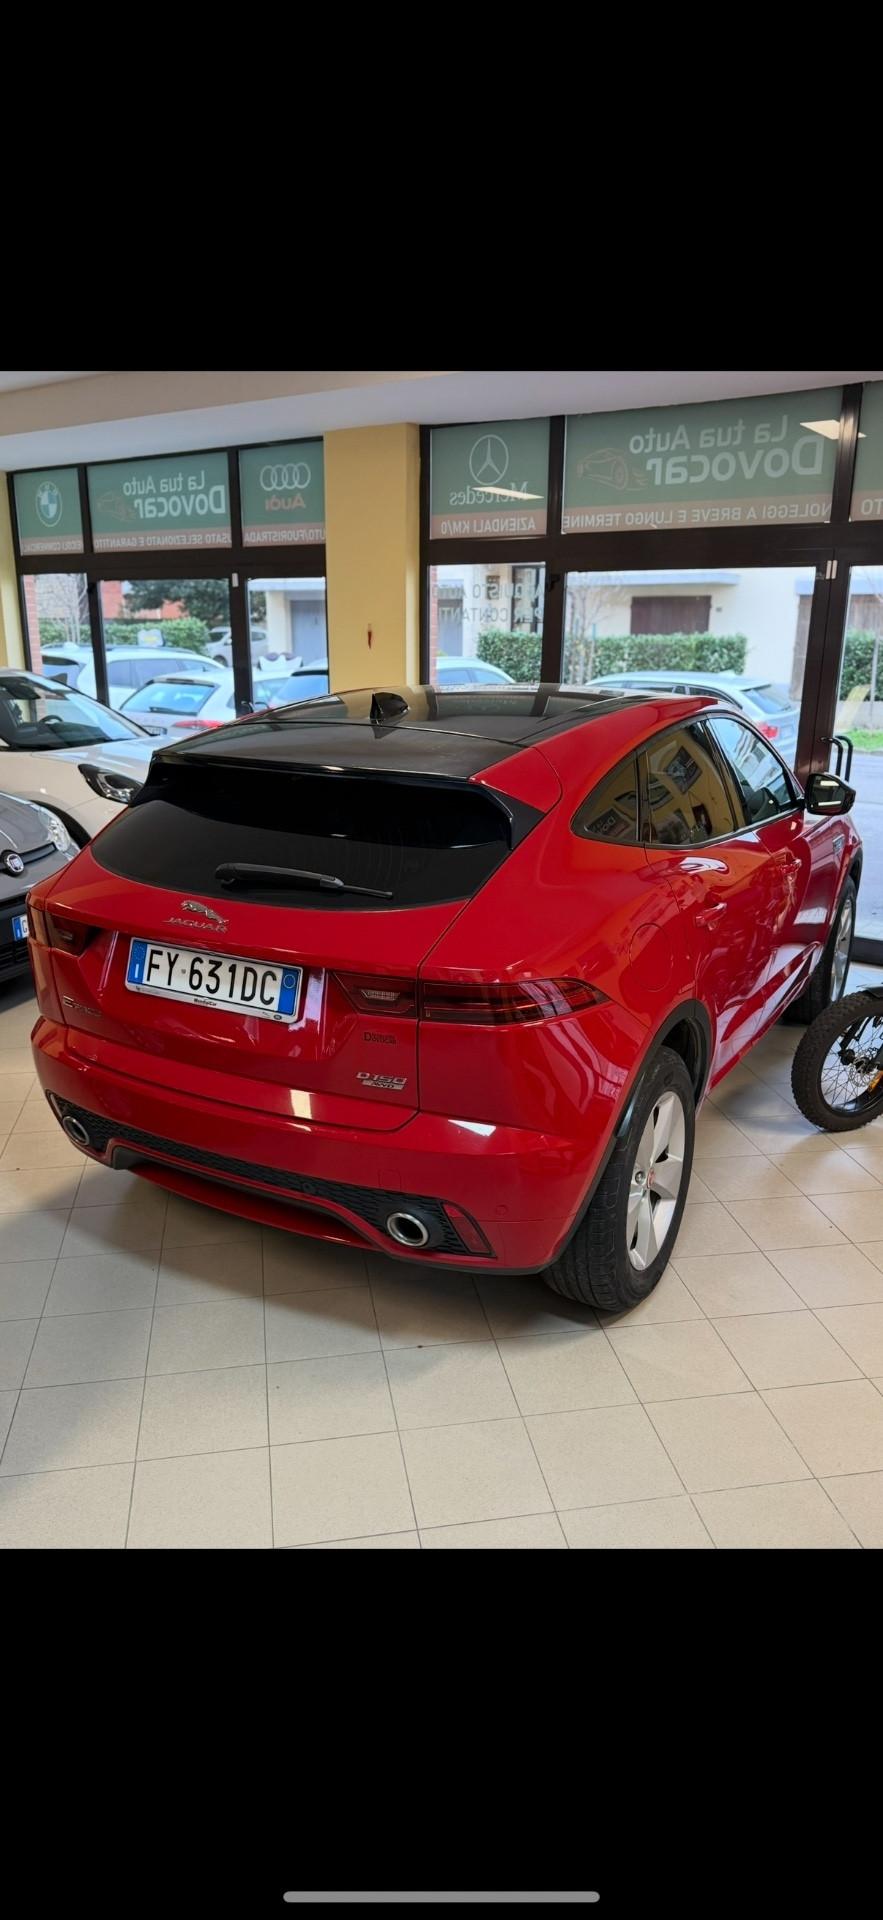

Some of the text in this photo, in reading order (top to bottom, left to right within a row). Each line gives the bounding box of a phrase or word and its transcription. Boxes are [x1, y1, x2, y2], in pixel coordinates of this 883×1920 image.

[162, 917, 228, 933] JAGUAR
[146, 949, 278, 1006] FY 631DC
